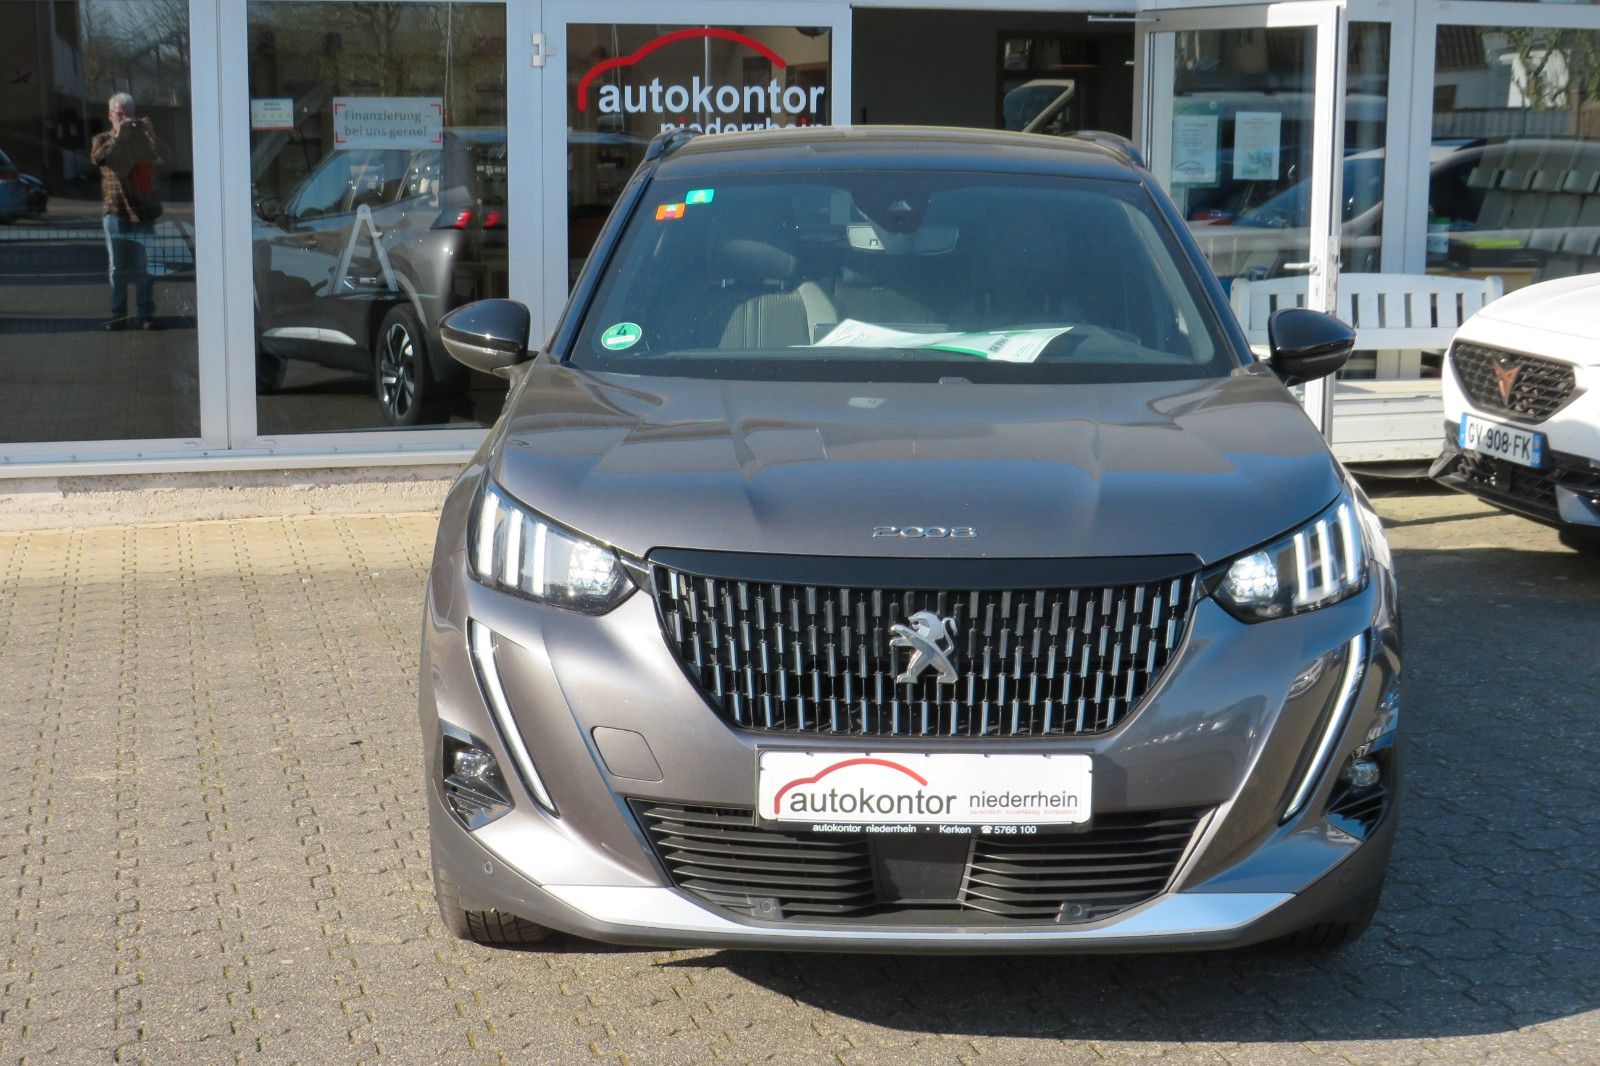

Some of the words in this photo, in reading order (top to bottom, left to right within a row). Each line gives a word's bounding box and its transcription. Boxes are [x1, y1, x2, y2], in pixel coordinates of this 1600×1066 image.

[598, 76, 825, 113] autokontor
[344, 109, 422, 124] Finanzierung
[344, 125, 363, 136] bei
[366, 127, 387, 136] uns
[617, 325, 627, 335] 4
[872, 526, 978, 538] 2008
[790, 787, 957, 815] autokontor
[970, 790, 1078, 808] niederrhein
[812, 823, 862, 833] autokontor
[866, 824, 917, 833] niederrhein
[939, 825, 971, 834] Kerken
[994, 825, 1018, 834] 5766
[1020, 825, 1037, 834] 100
